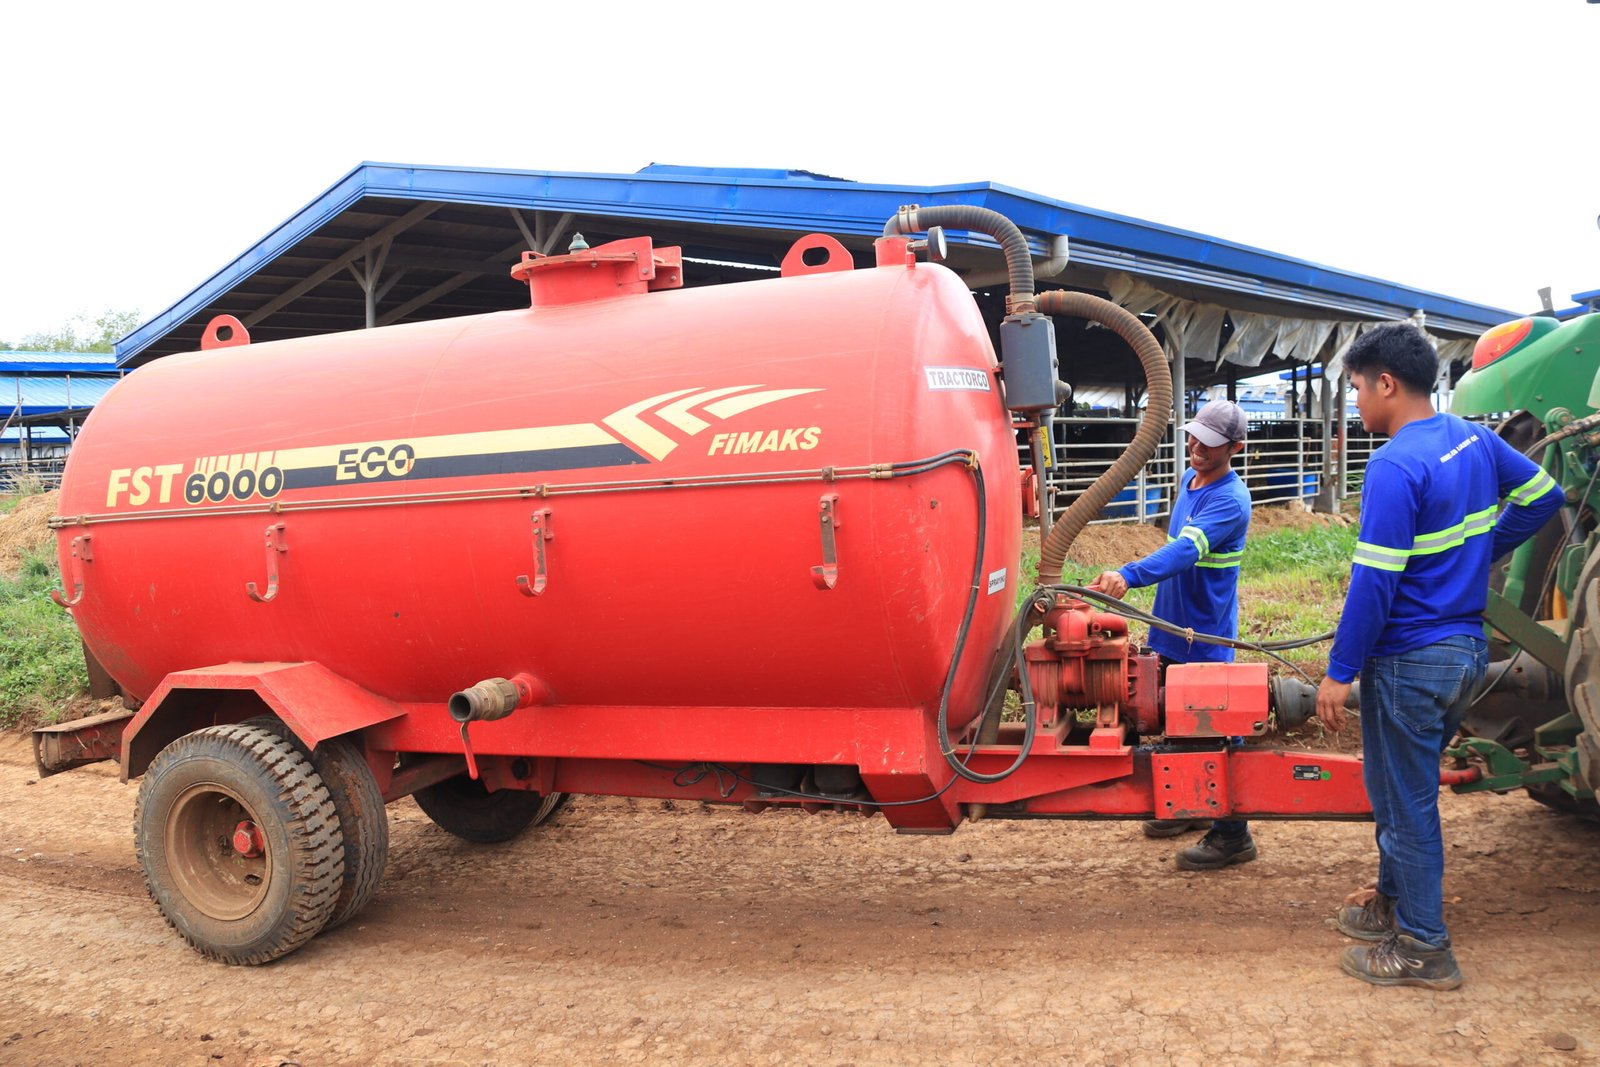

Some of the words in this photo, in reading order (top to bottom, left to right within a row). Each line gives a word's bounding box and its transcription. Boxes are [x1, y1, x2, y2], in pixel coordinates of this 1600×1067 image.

[928, 370, 988, 388] TRACTORCO
[106, 463, 185, 508] FST
[184, 465, 285, 506] 6000
[335, 443, 416, 481] ECO
